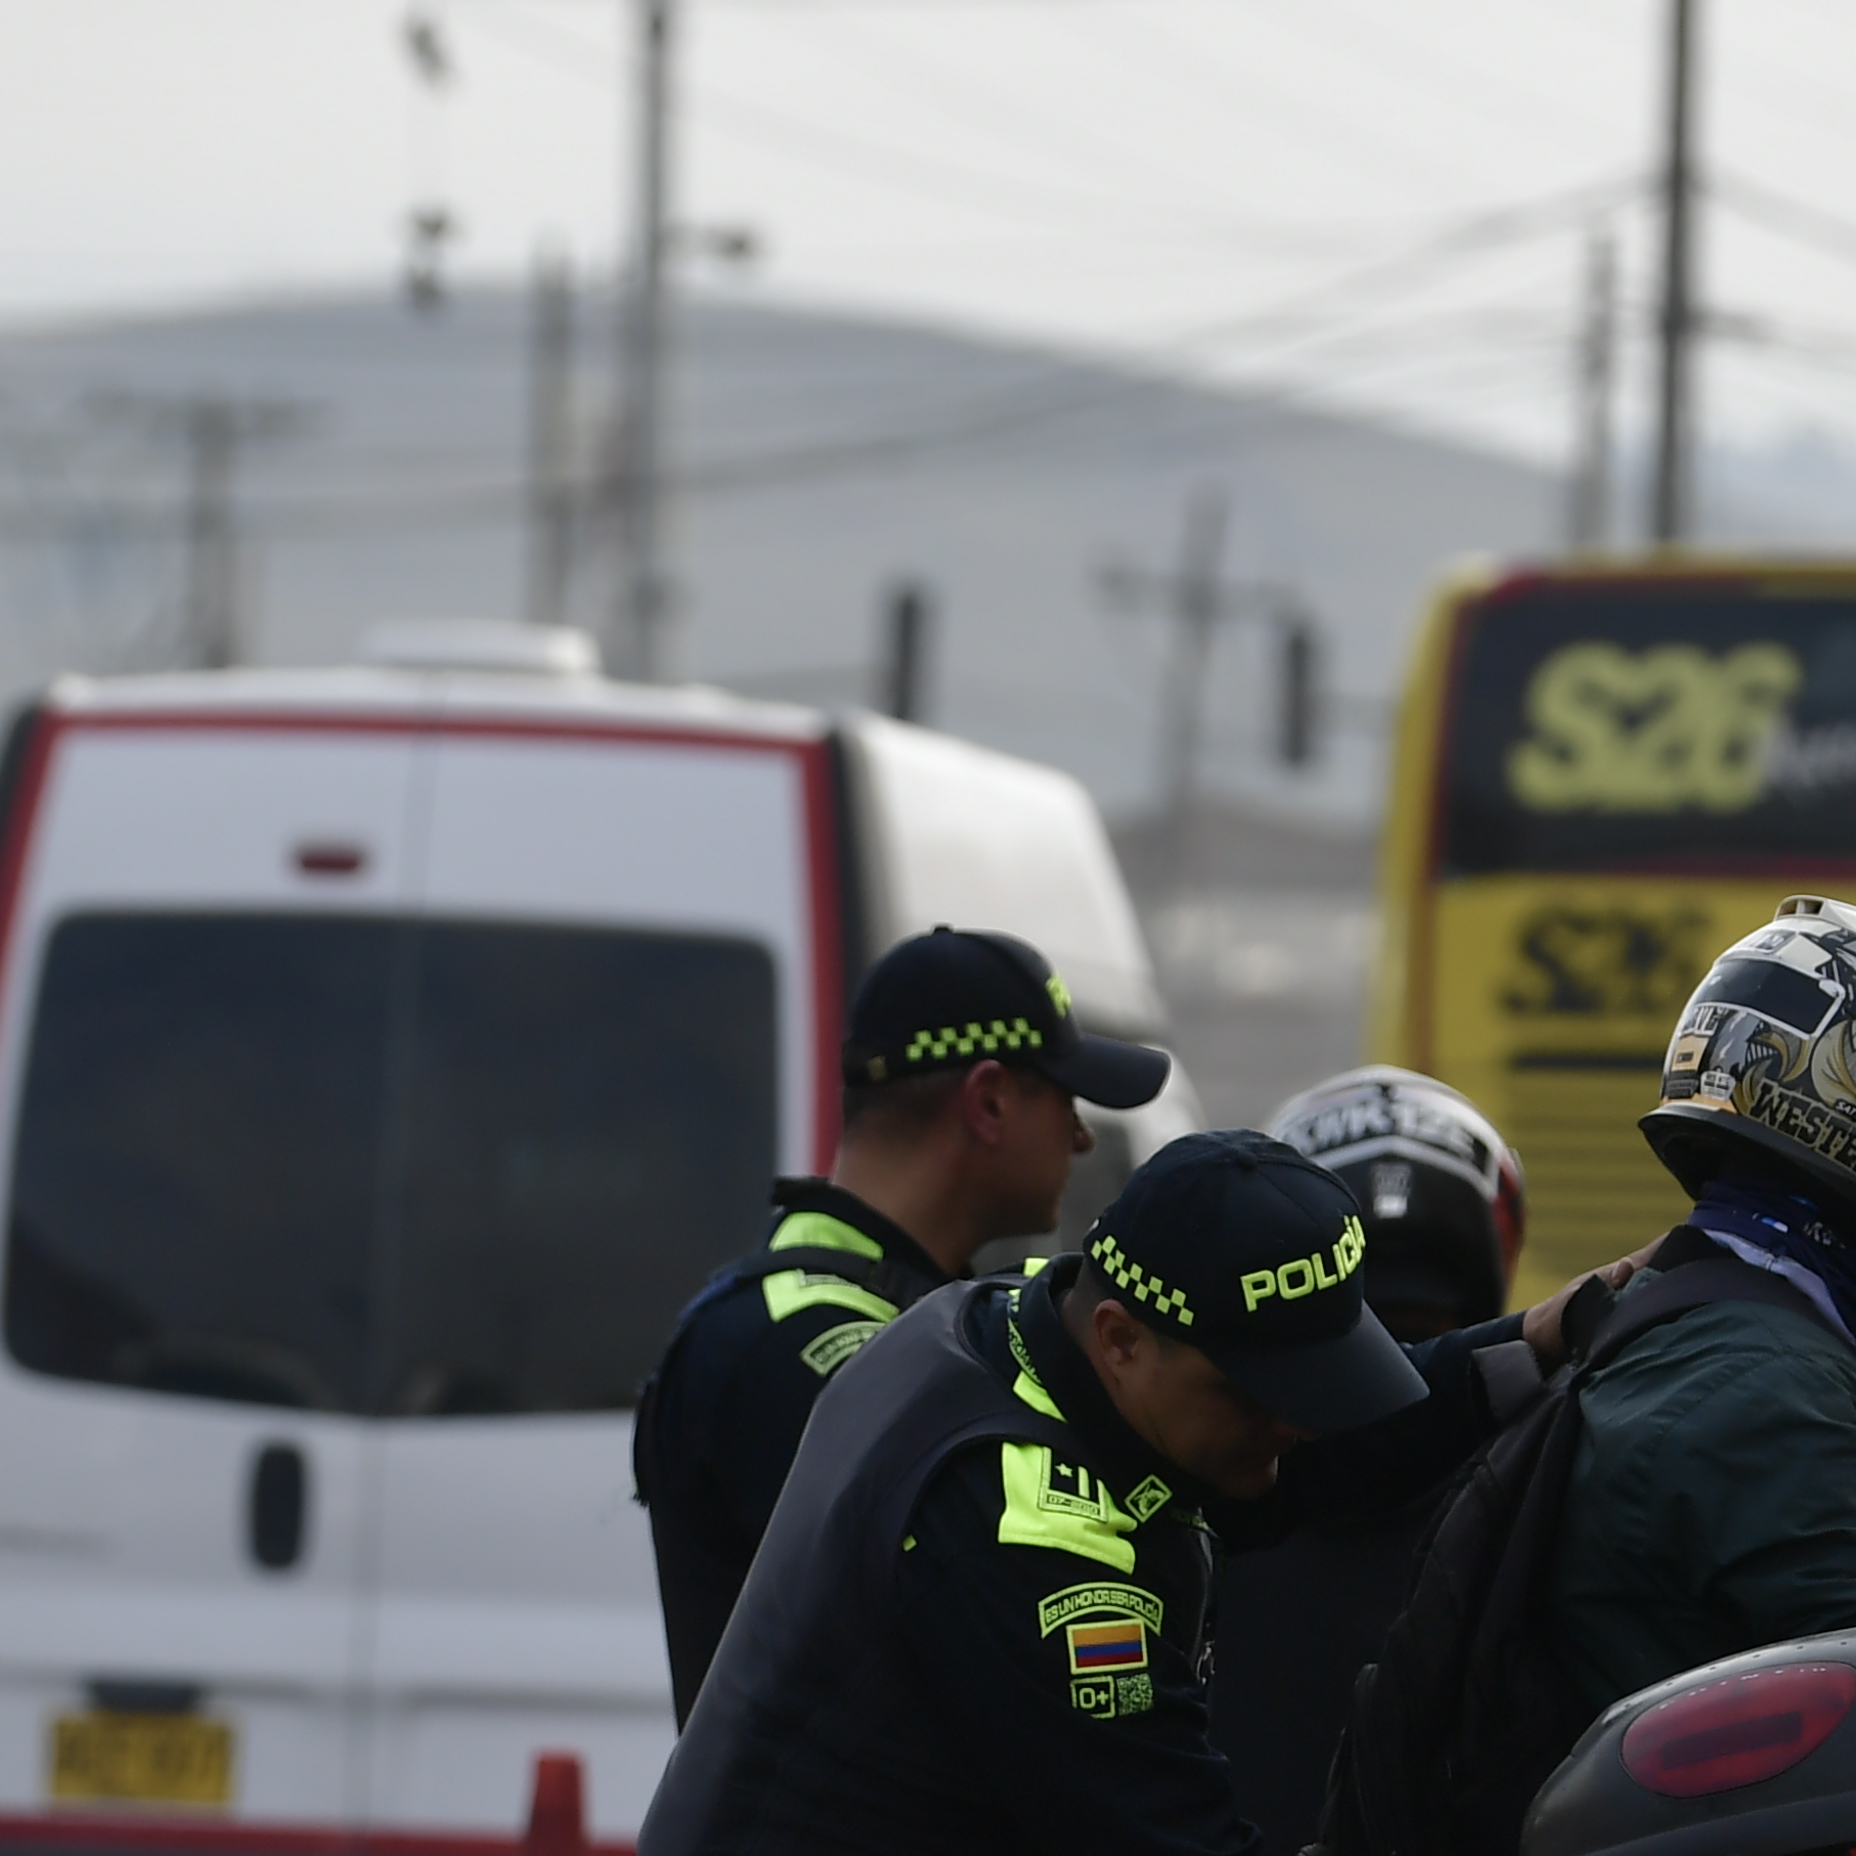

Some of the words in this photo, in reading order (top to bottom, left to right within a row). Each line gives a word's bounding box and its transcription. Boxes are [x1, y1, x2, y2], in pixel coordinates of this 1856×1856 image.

[1510, 644, 1797, 811] S26
[1240, 1214, 1366, 1312] POLICÍA
[1075, 1590, 1109, 1608] HONOR
